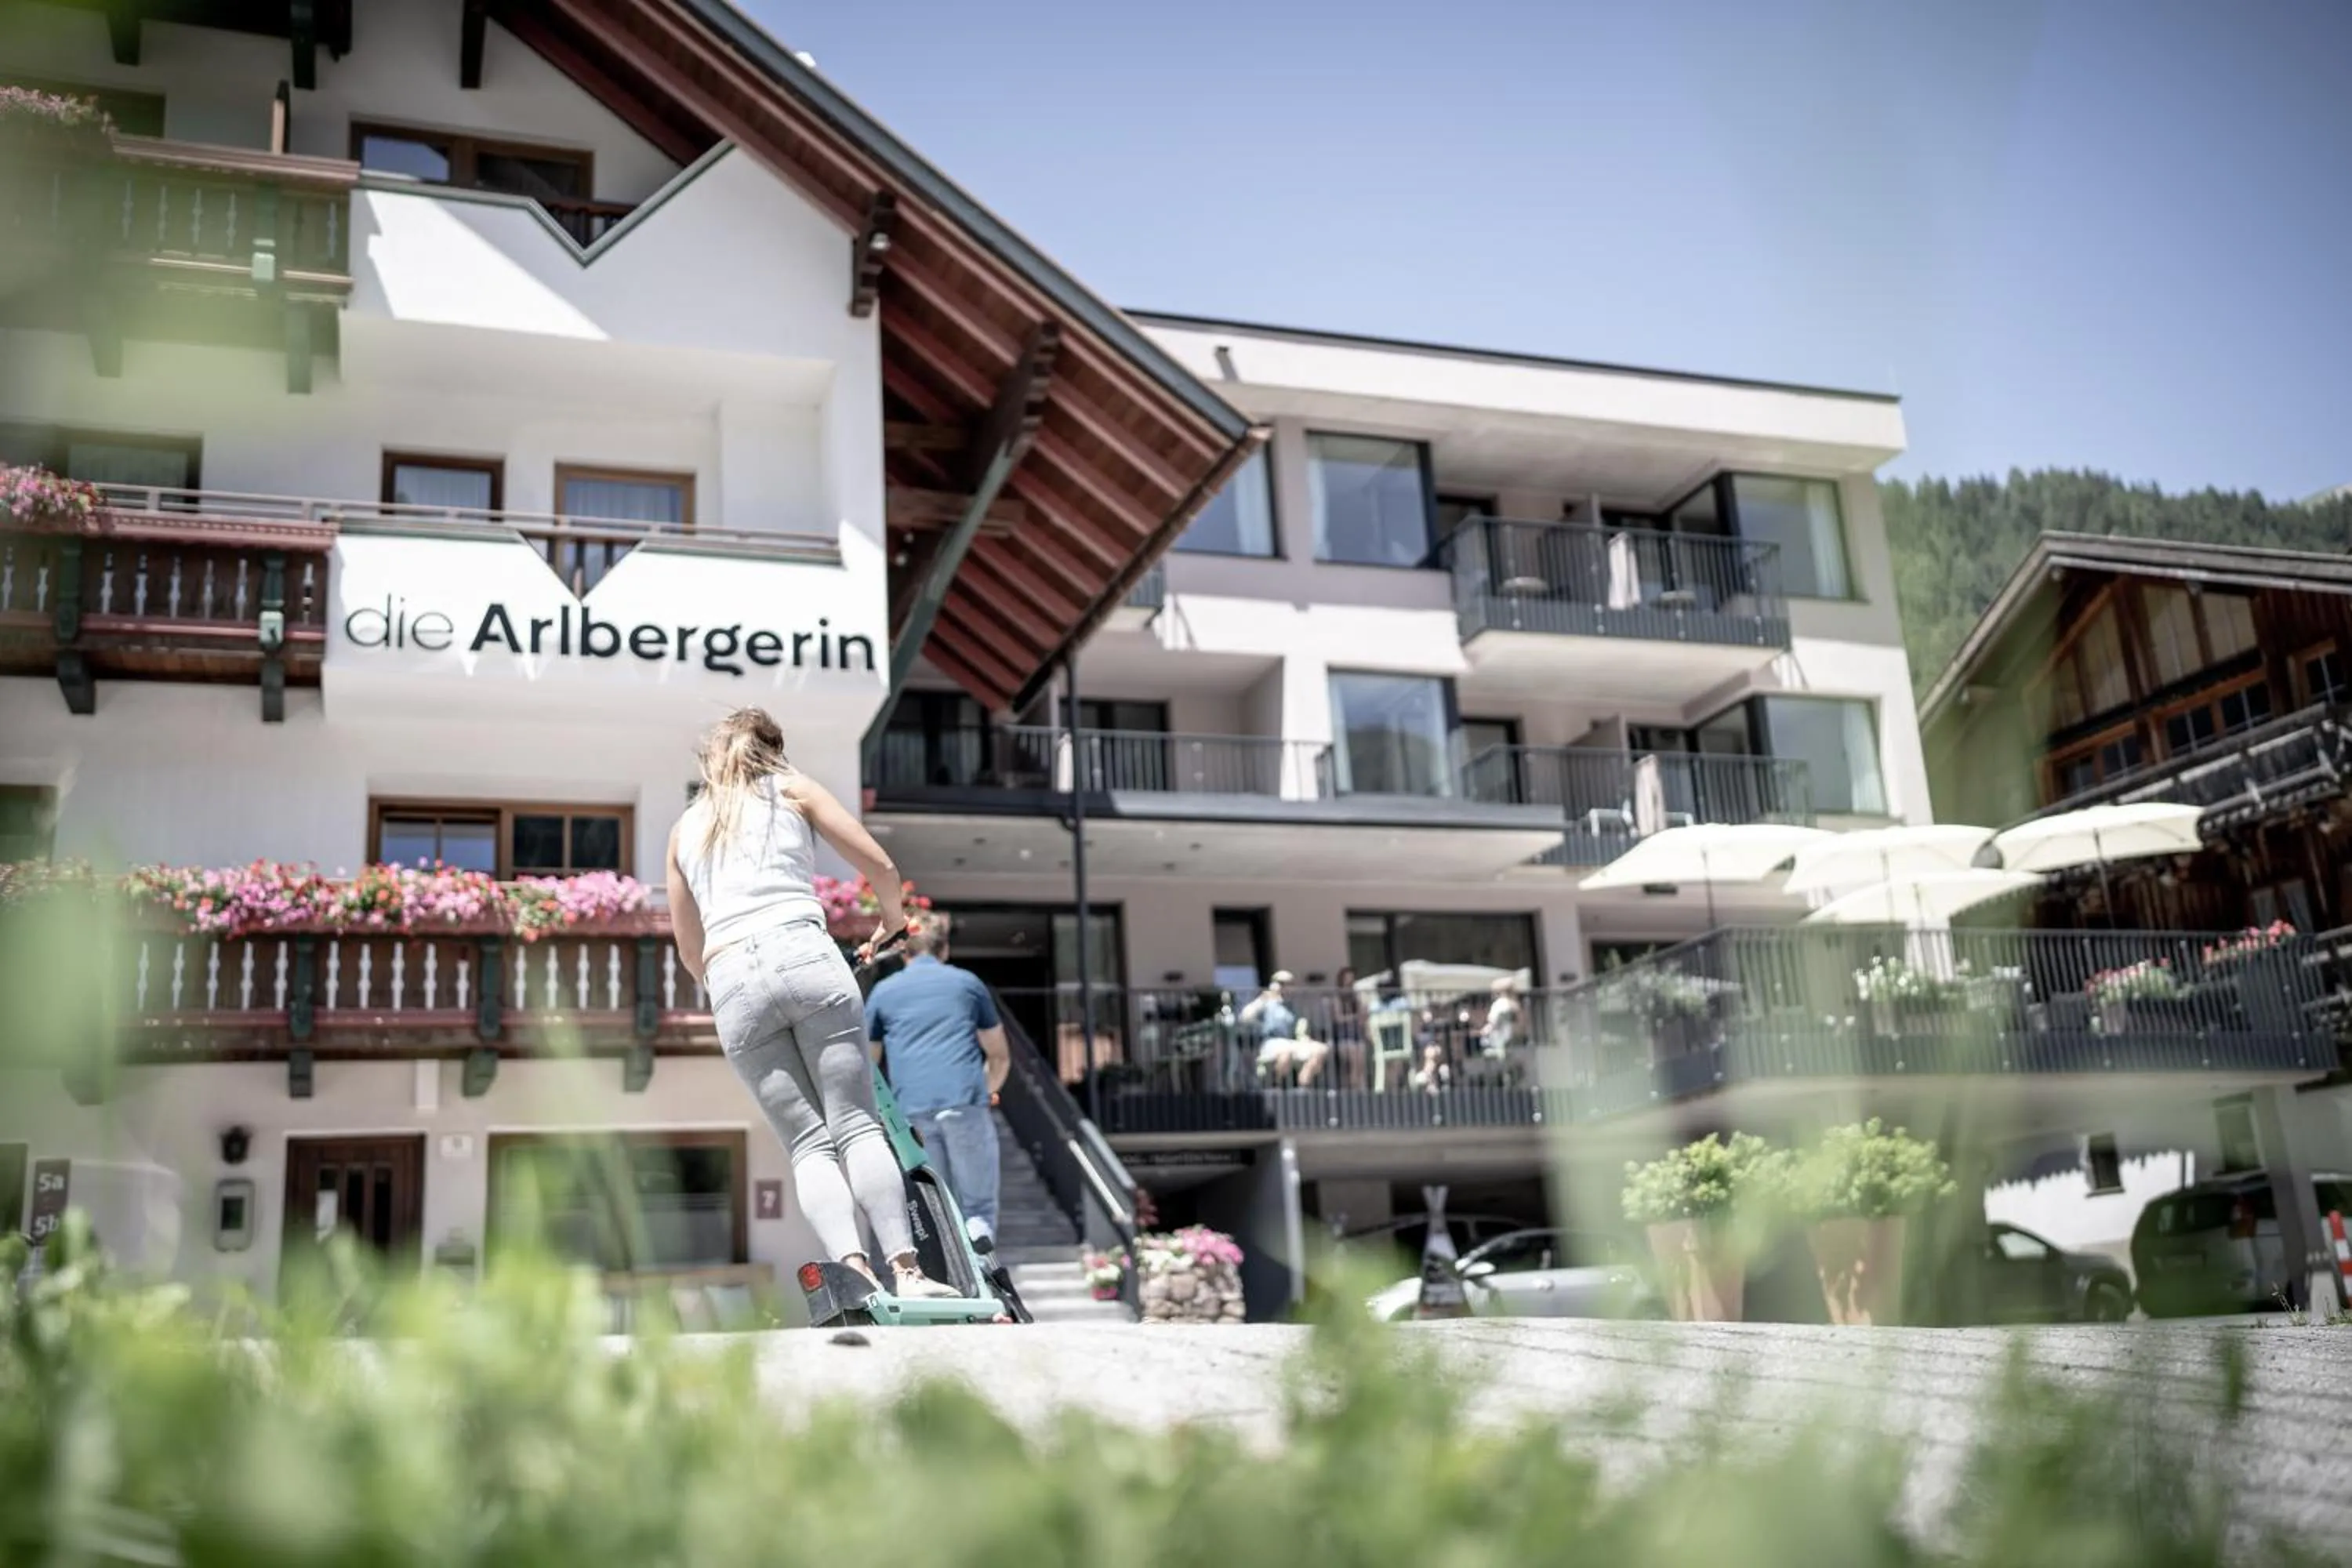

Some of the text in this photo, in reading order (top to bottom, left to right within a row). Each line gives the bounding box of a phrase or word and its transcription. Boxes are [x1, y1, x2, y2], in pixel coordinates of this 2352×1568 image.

[345, 593, 875, 677] die Arlbergerin
[38, 1173, 64, 1192] 5a
